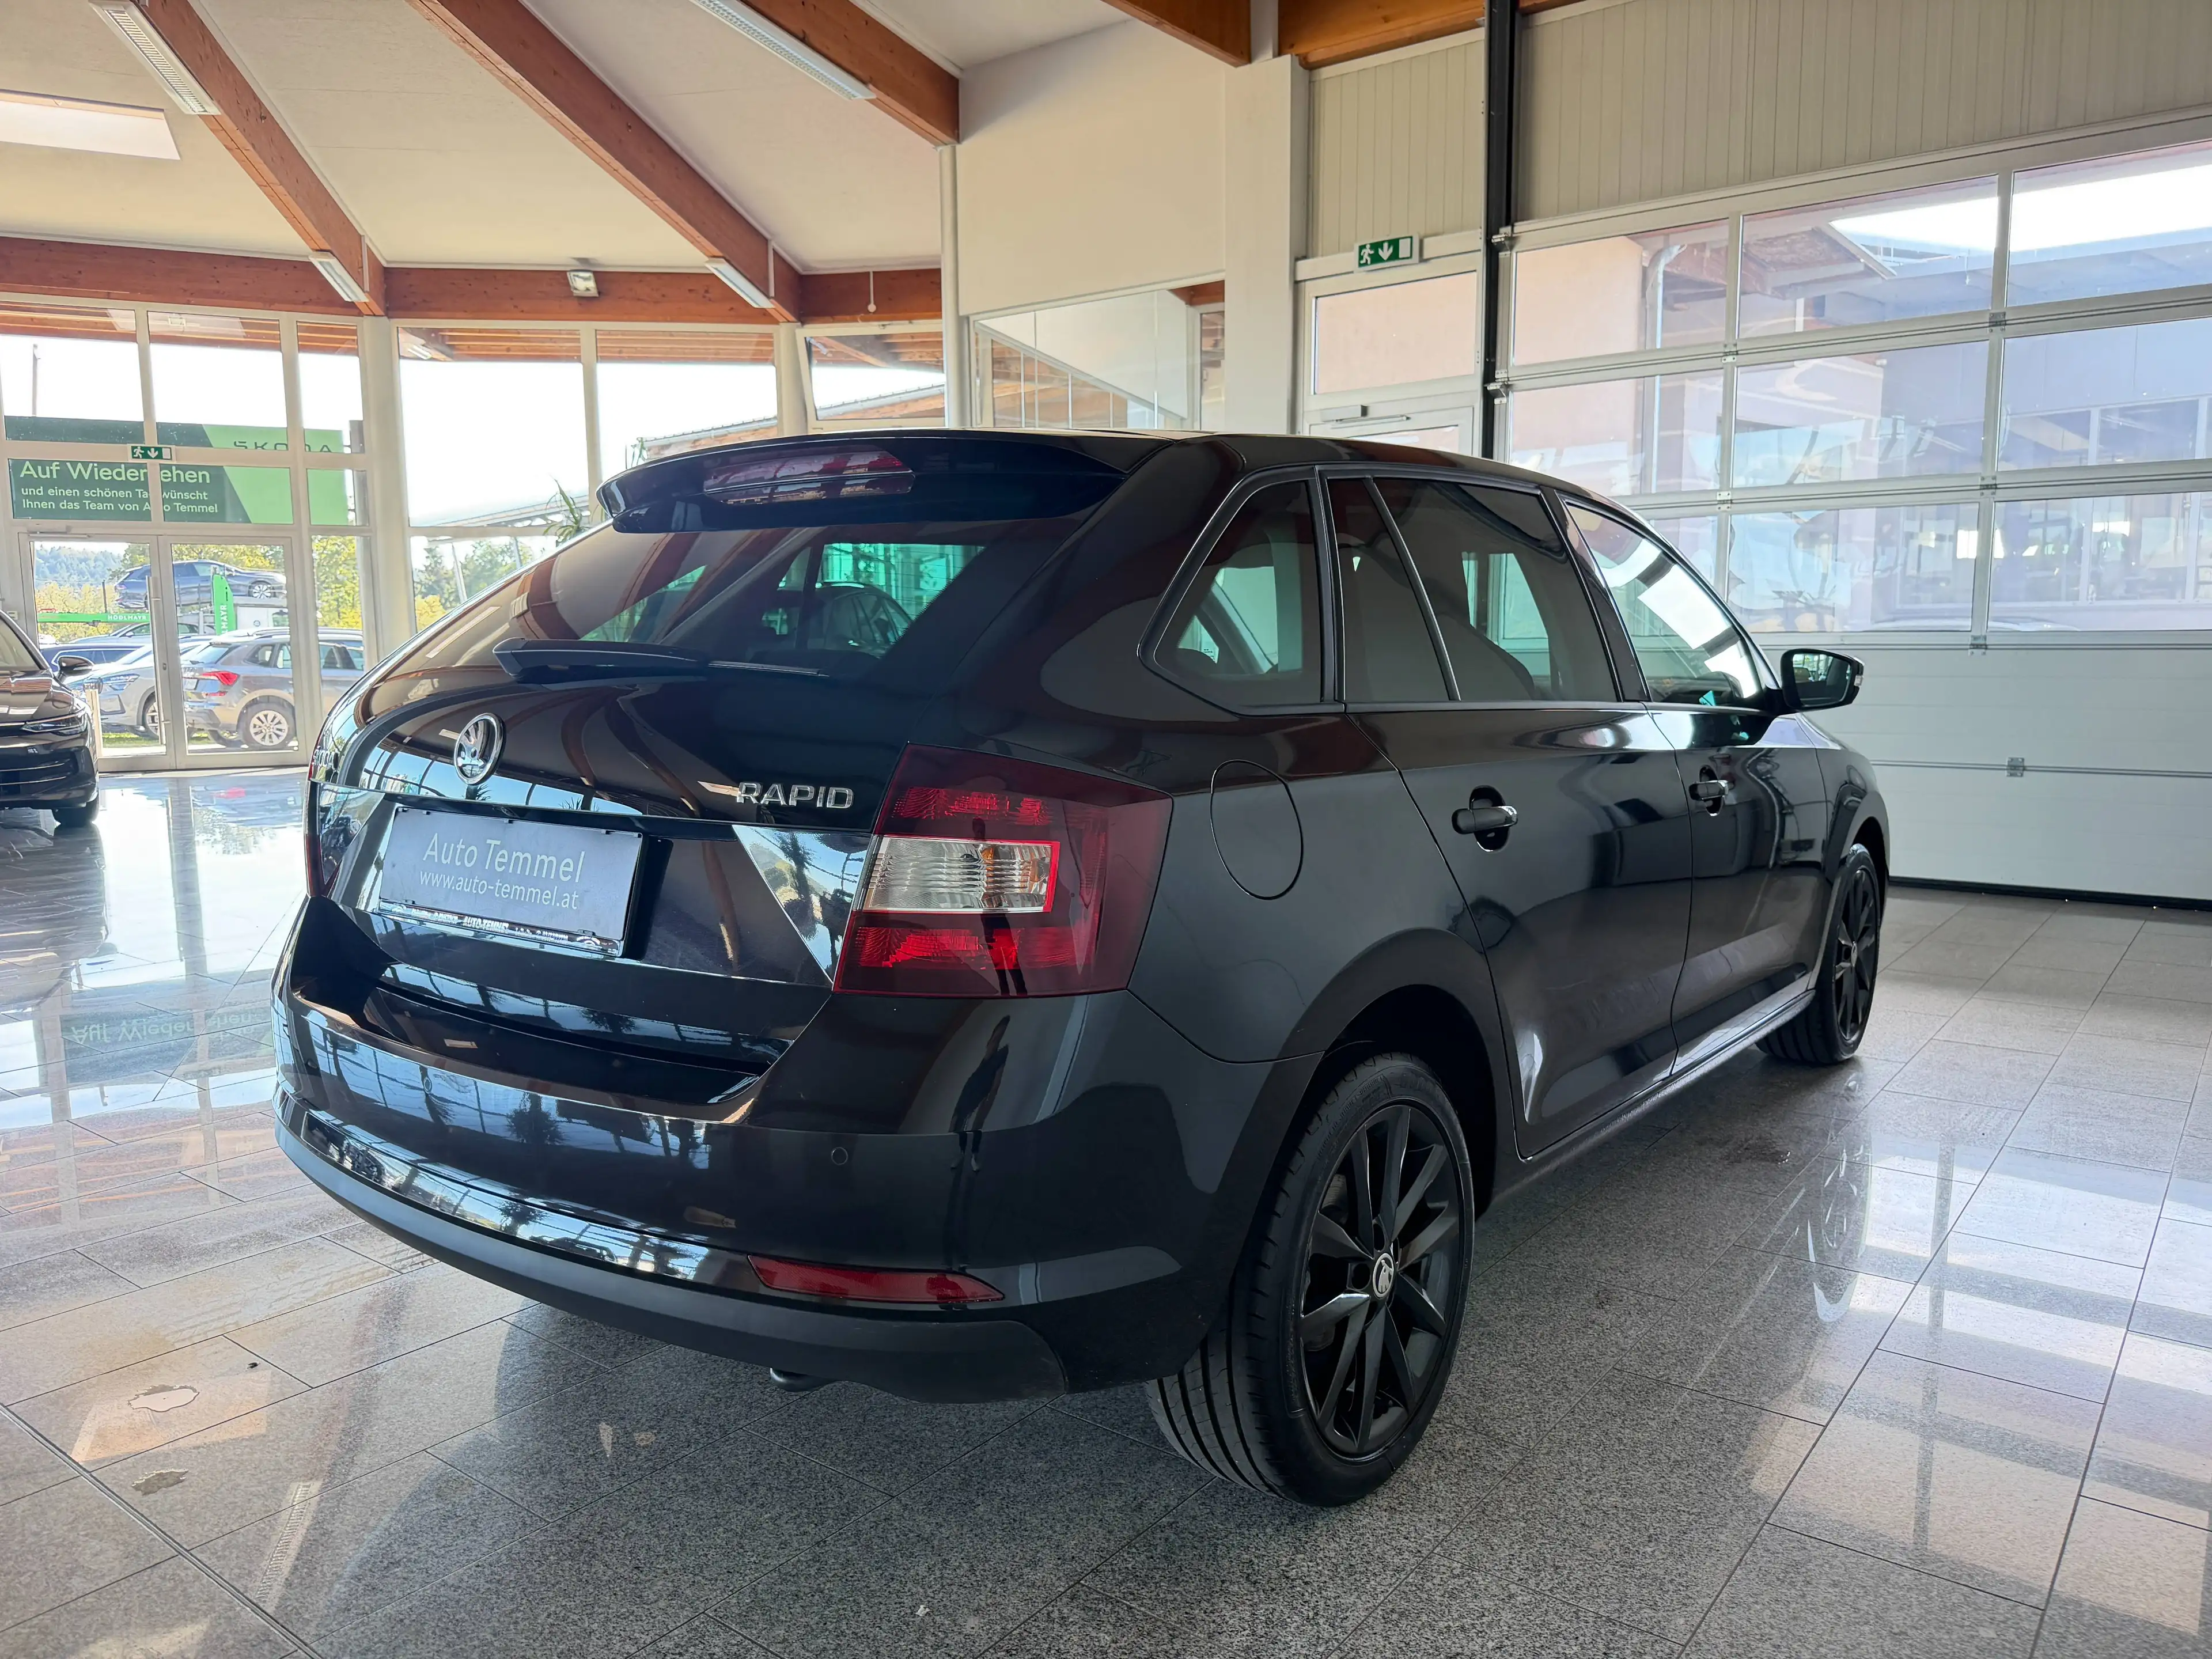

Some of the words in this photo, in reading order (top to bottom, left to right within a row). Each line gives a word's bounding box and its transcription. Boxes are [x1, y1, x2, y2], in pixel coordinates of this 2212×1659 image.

[20, 460, 60, 478] Auf
[66, 462, 210, 483] Wiederehen
[21, 486, 44, 495] und
[47, 487, 80, 497] einen
[84, 487, 132, 498] schönen
[135, 488, 150, 499] Ta
[162, 490, 208, 499] wünscht
[22, 499, 55, 509] Ihnen
[59, 500, 80, 509] das
[83, 501, 114, 510] Team
[118, 503, 139, 511] von
[143, 502, 171, 512] Ao
[173, 502, 218, 513] Temmel
[737, 782, 854, 809] RAPID
[423, 832, 478, 868] Auto
[485, 838, 586, 883] Temmel
[419, 870, 579, 910] www.auto-temmel.at
